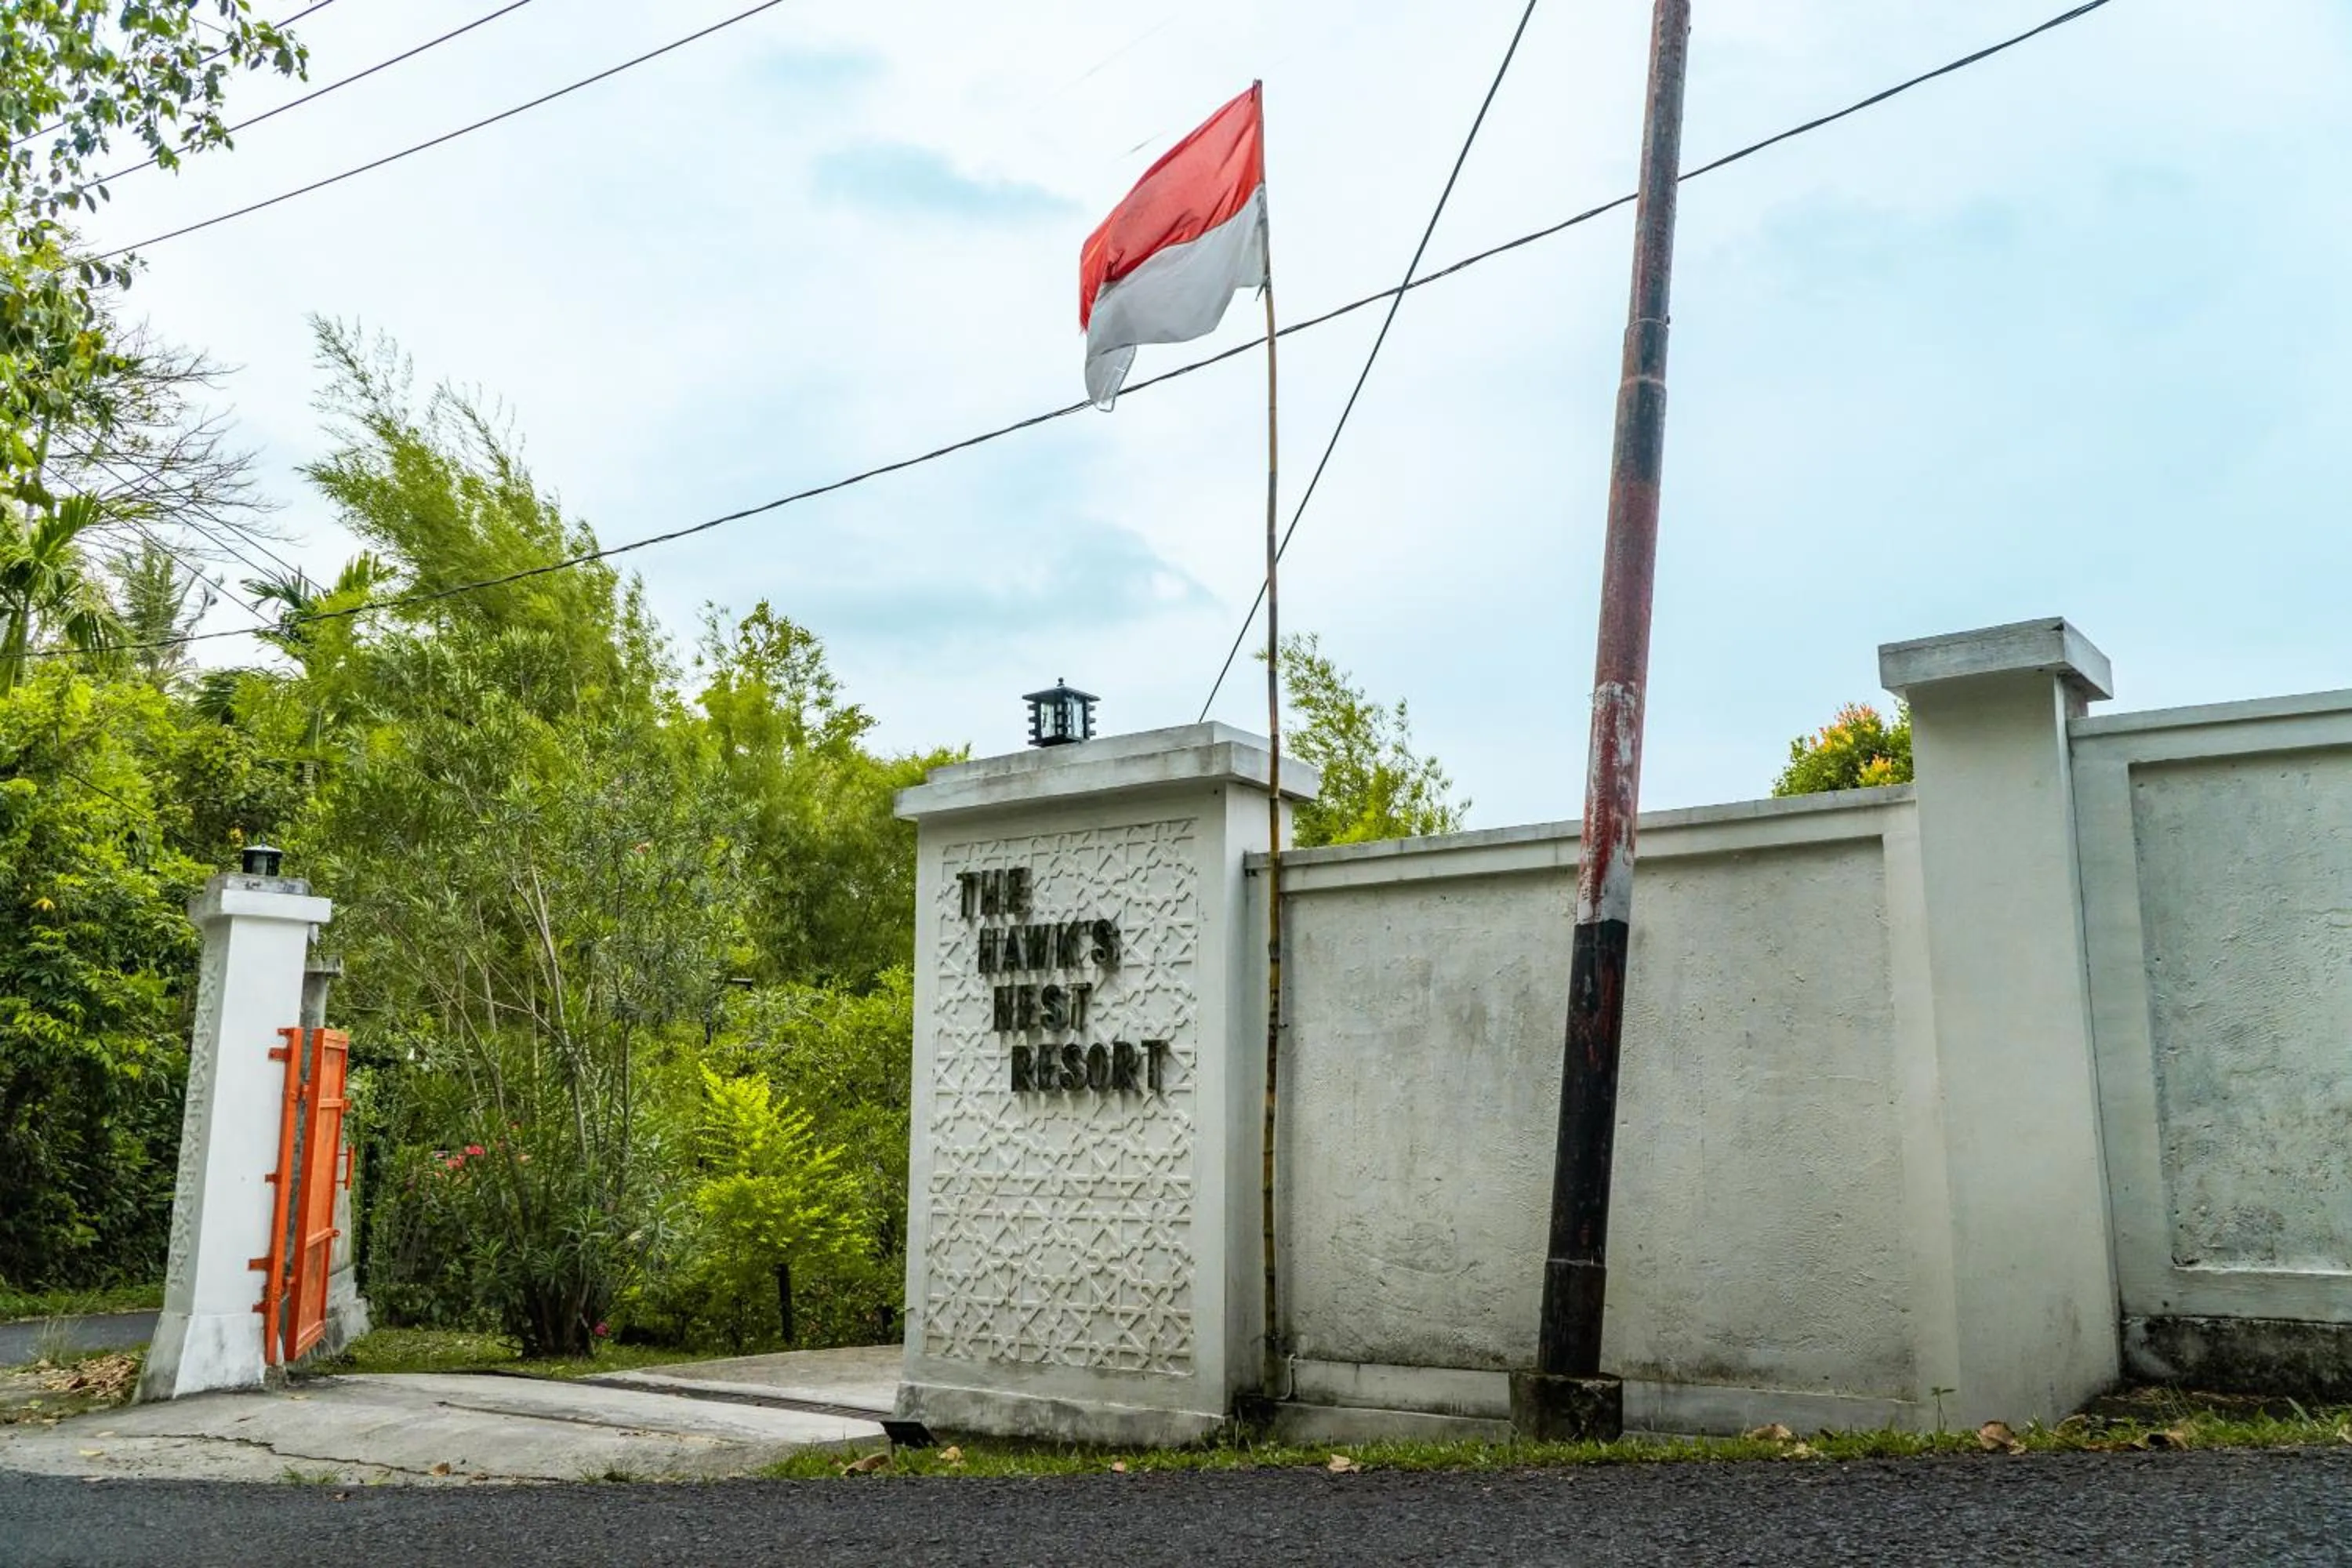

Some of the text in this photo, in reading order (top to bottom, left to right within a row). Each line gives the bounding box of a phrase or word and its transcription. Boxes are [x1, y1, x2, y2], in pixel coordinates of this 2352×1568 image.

[956, 867, 1032, 917] THE
[993, 982, 1092, 1033] NEST
[1011, 1040, 1168, 1093] RESORT
